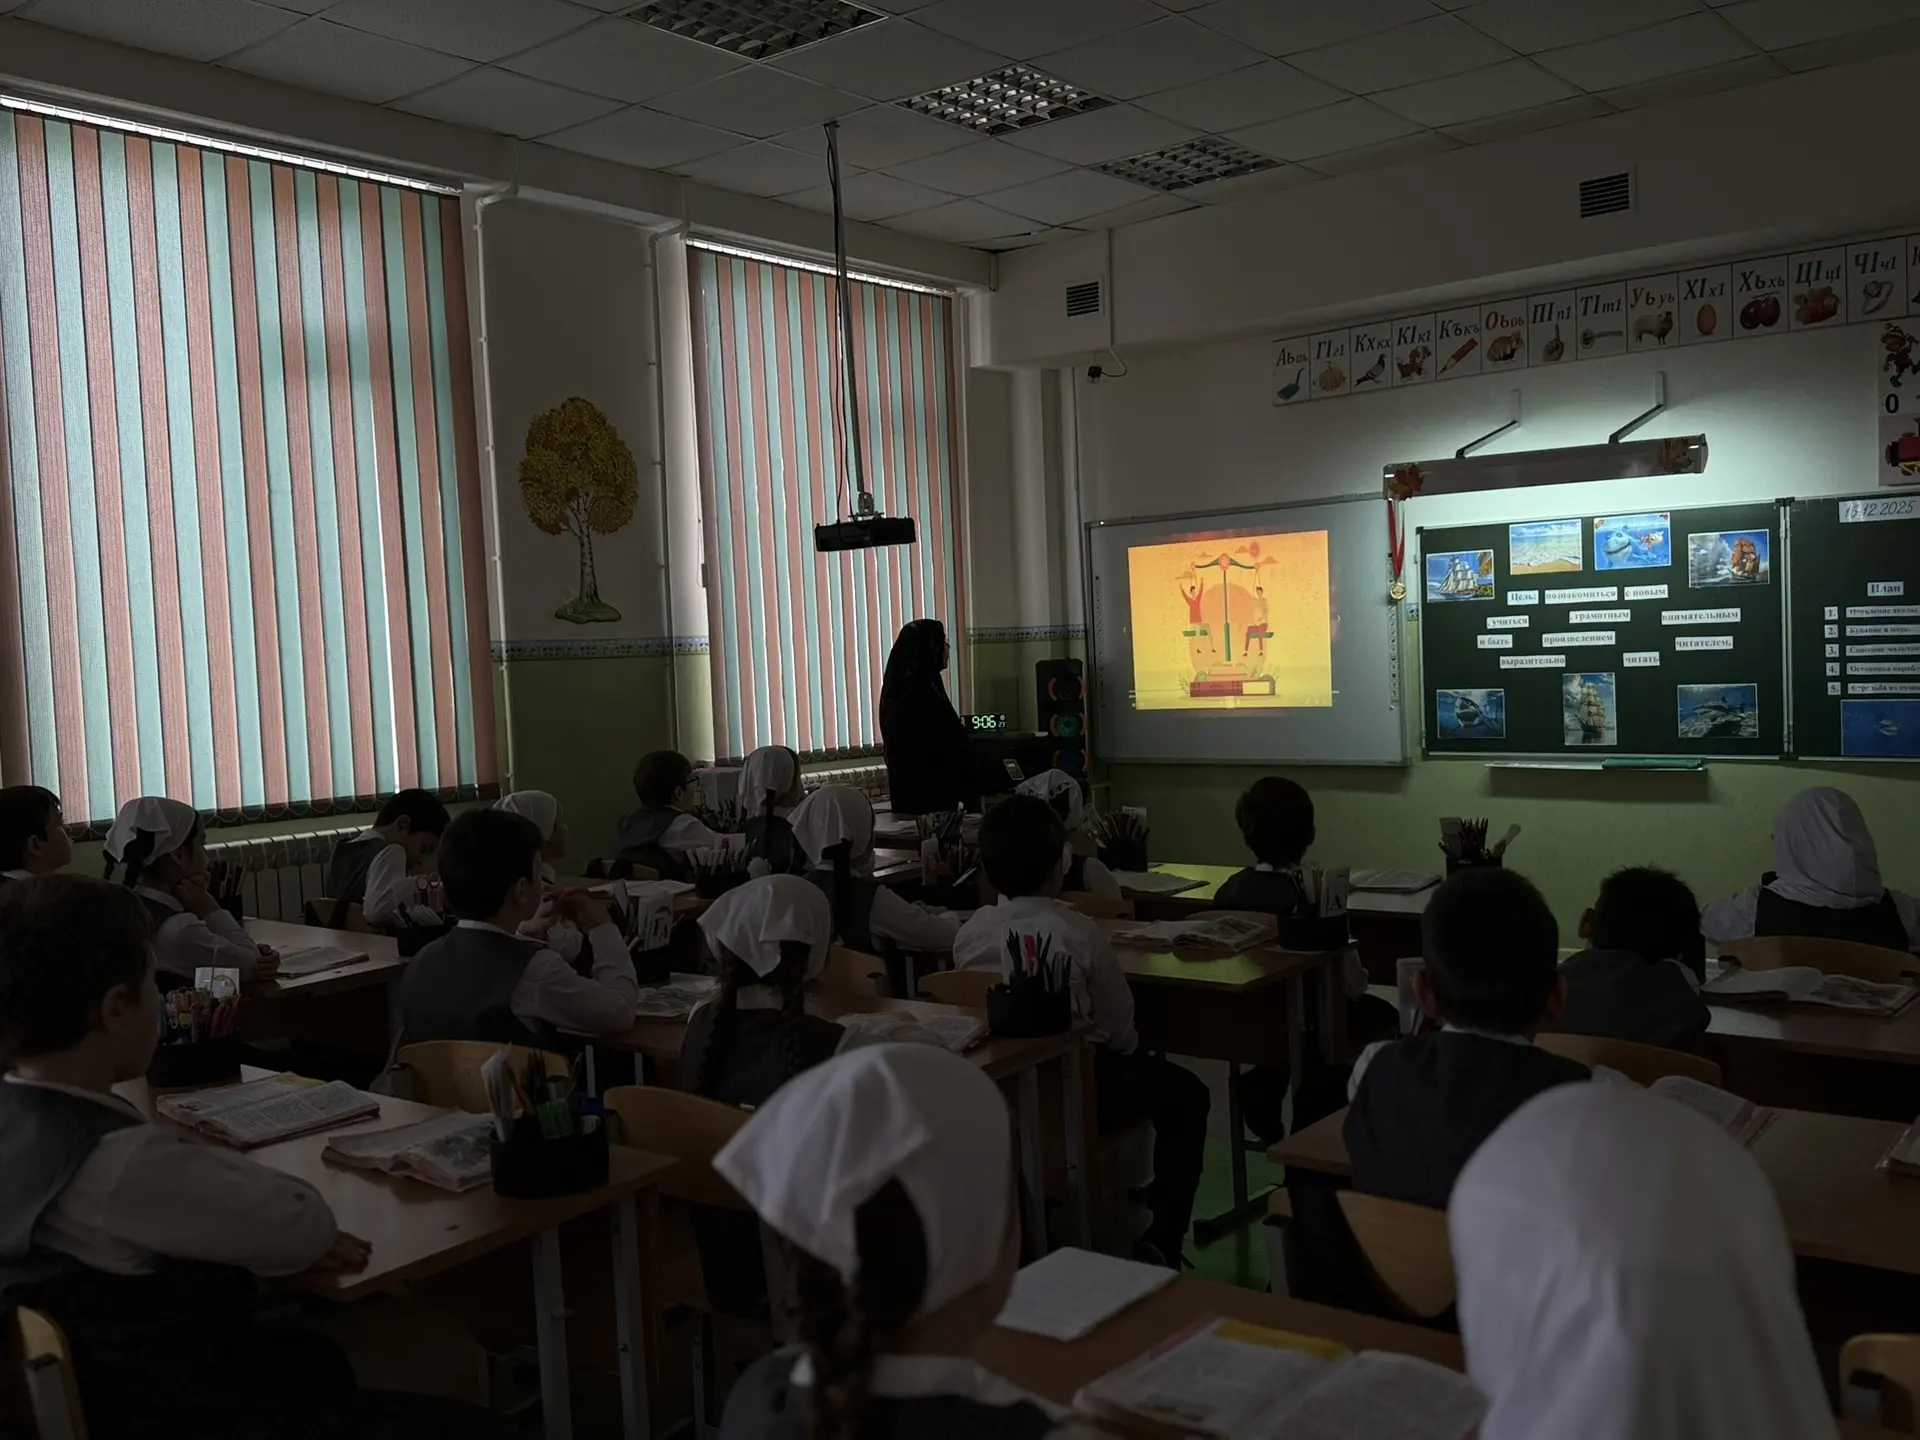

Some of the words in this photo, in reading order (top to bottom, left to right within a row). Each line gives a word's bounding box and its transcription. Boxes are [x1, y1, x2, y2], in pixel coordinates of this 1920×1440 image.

[1871, 584, 1900, 593] План
[1511, 593, 1536, 602] Цель:
[1545, 591, 1616, 600] познакомиться
[1633, 589, 1666, 597] новым
[1662, 612, 1739, 621] внимательным
[1487, 636, 1510, 645] быть
[1543, 634, 1613, 645] произведением
[1501, 657, 1565, 667] выразительно
[1625, 656, 1659, 664] читать
[972, 715, 997, 729] 9:06
